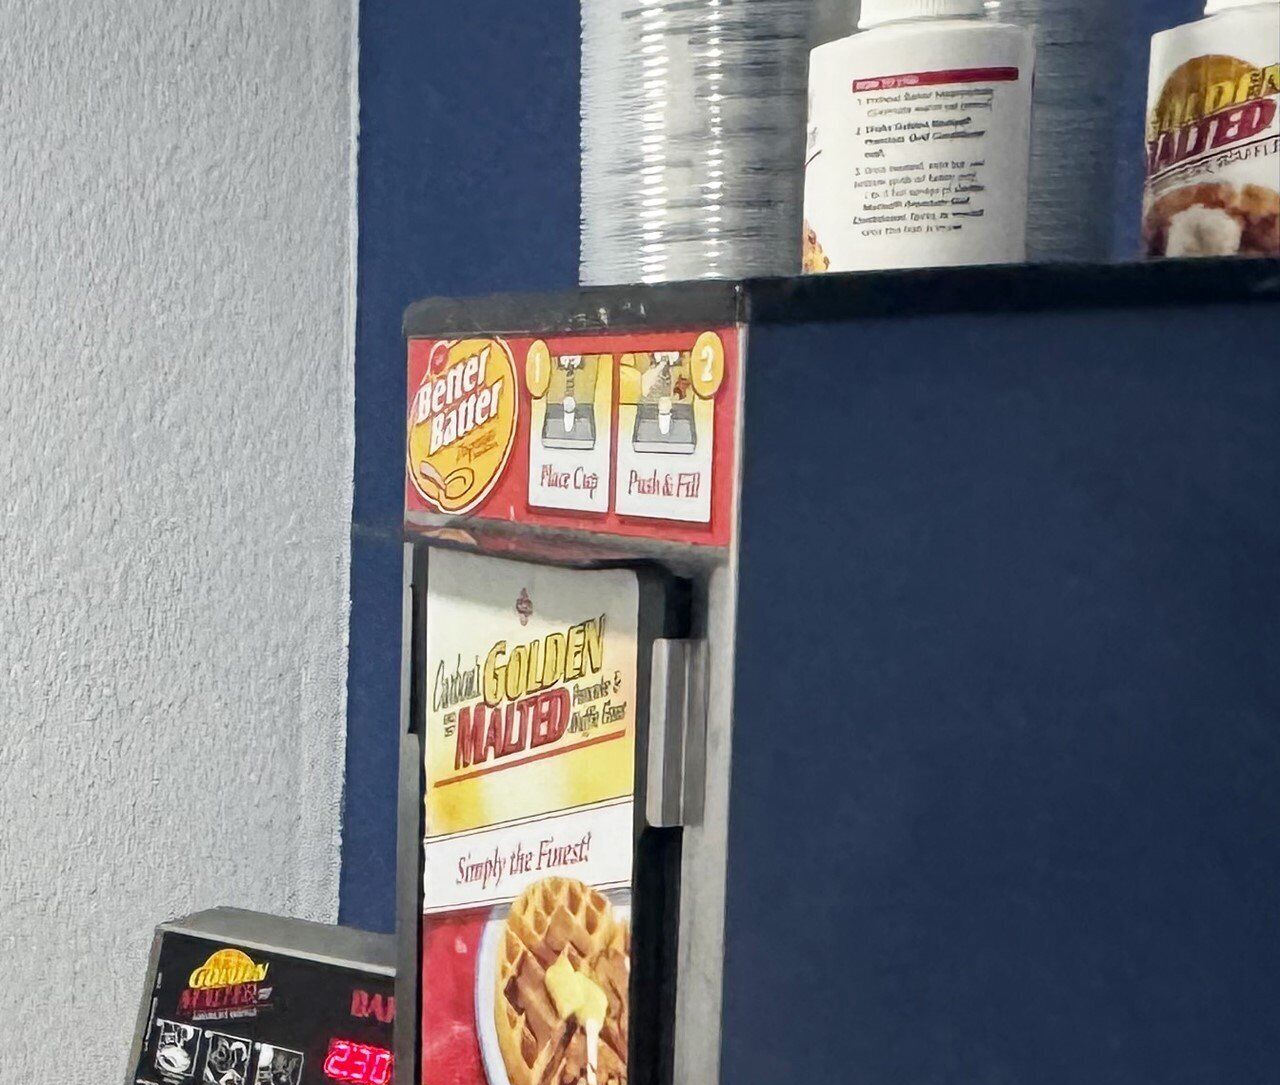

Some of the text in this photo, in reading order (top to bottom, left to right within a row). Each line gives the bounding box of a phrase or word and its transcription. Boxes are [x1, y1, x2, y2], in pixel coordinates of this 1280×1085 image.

[417, 344, 492, 427] Better
[700, 344, 715, 383] 2
[427, 376, 505, 458] Batter
[540, 463, 599, 499] Place Cup
[628, 469, 660, 495] Push
[676, 471, 701, 499] Fill
[483, 613, 607, 708] GOLDEN
[454, 686, 572, 771] MALTED
[456, 845, 506, 890] Simply
[509, 843, 533, 875] the
